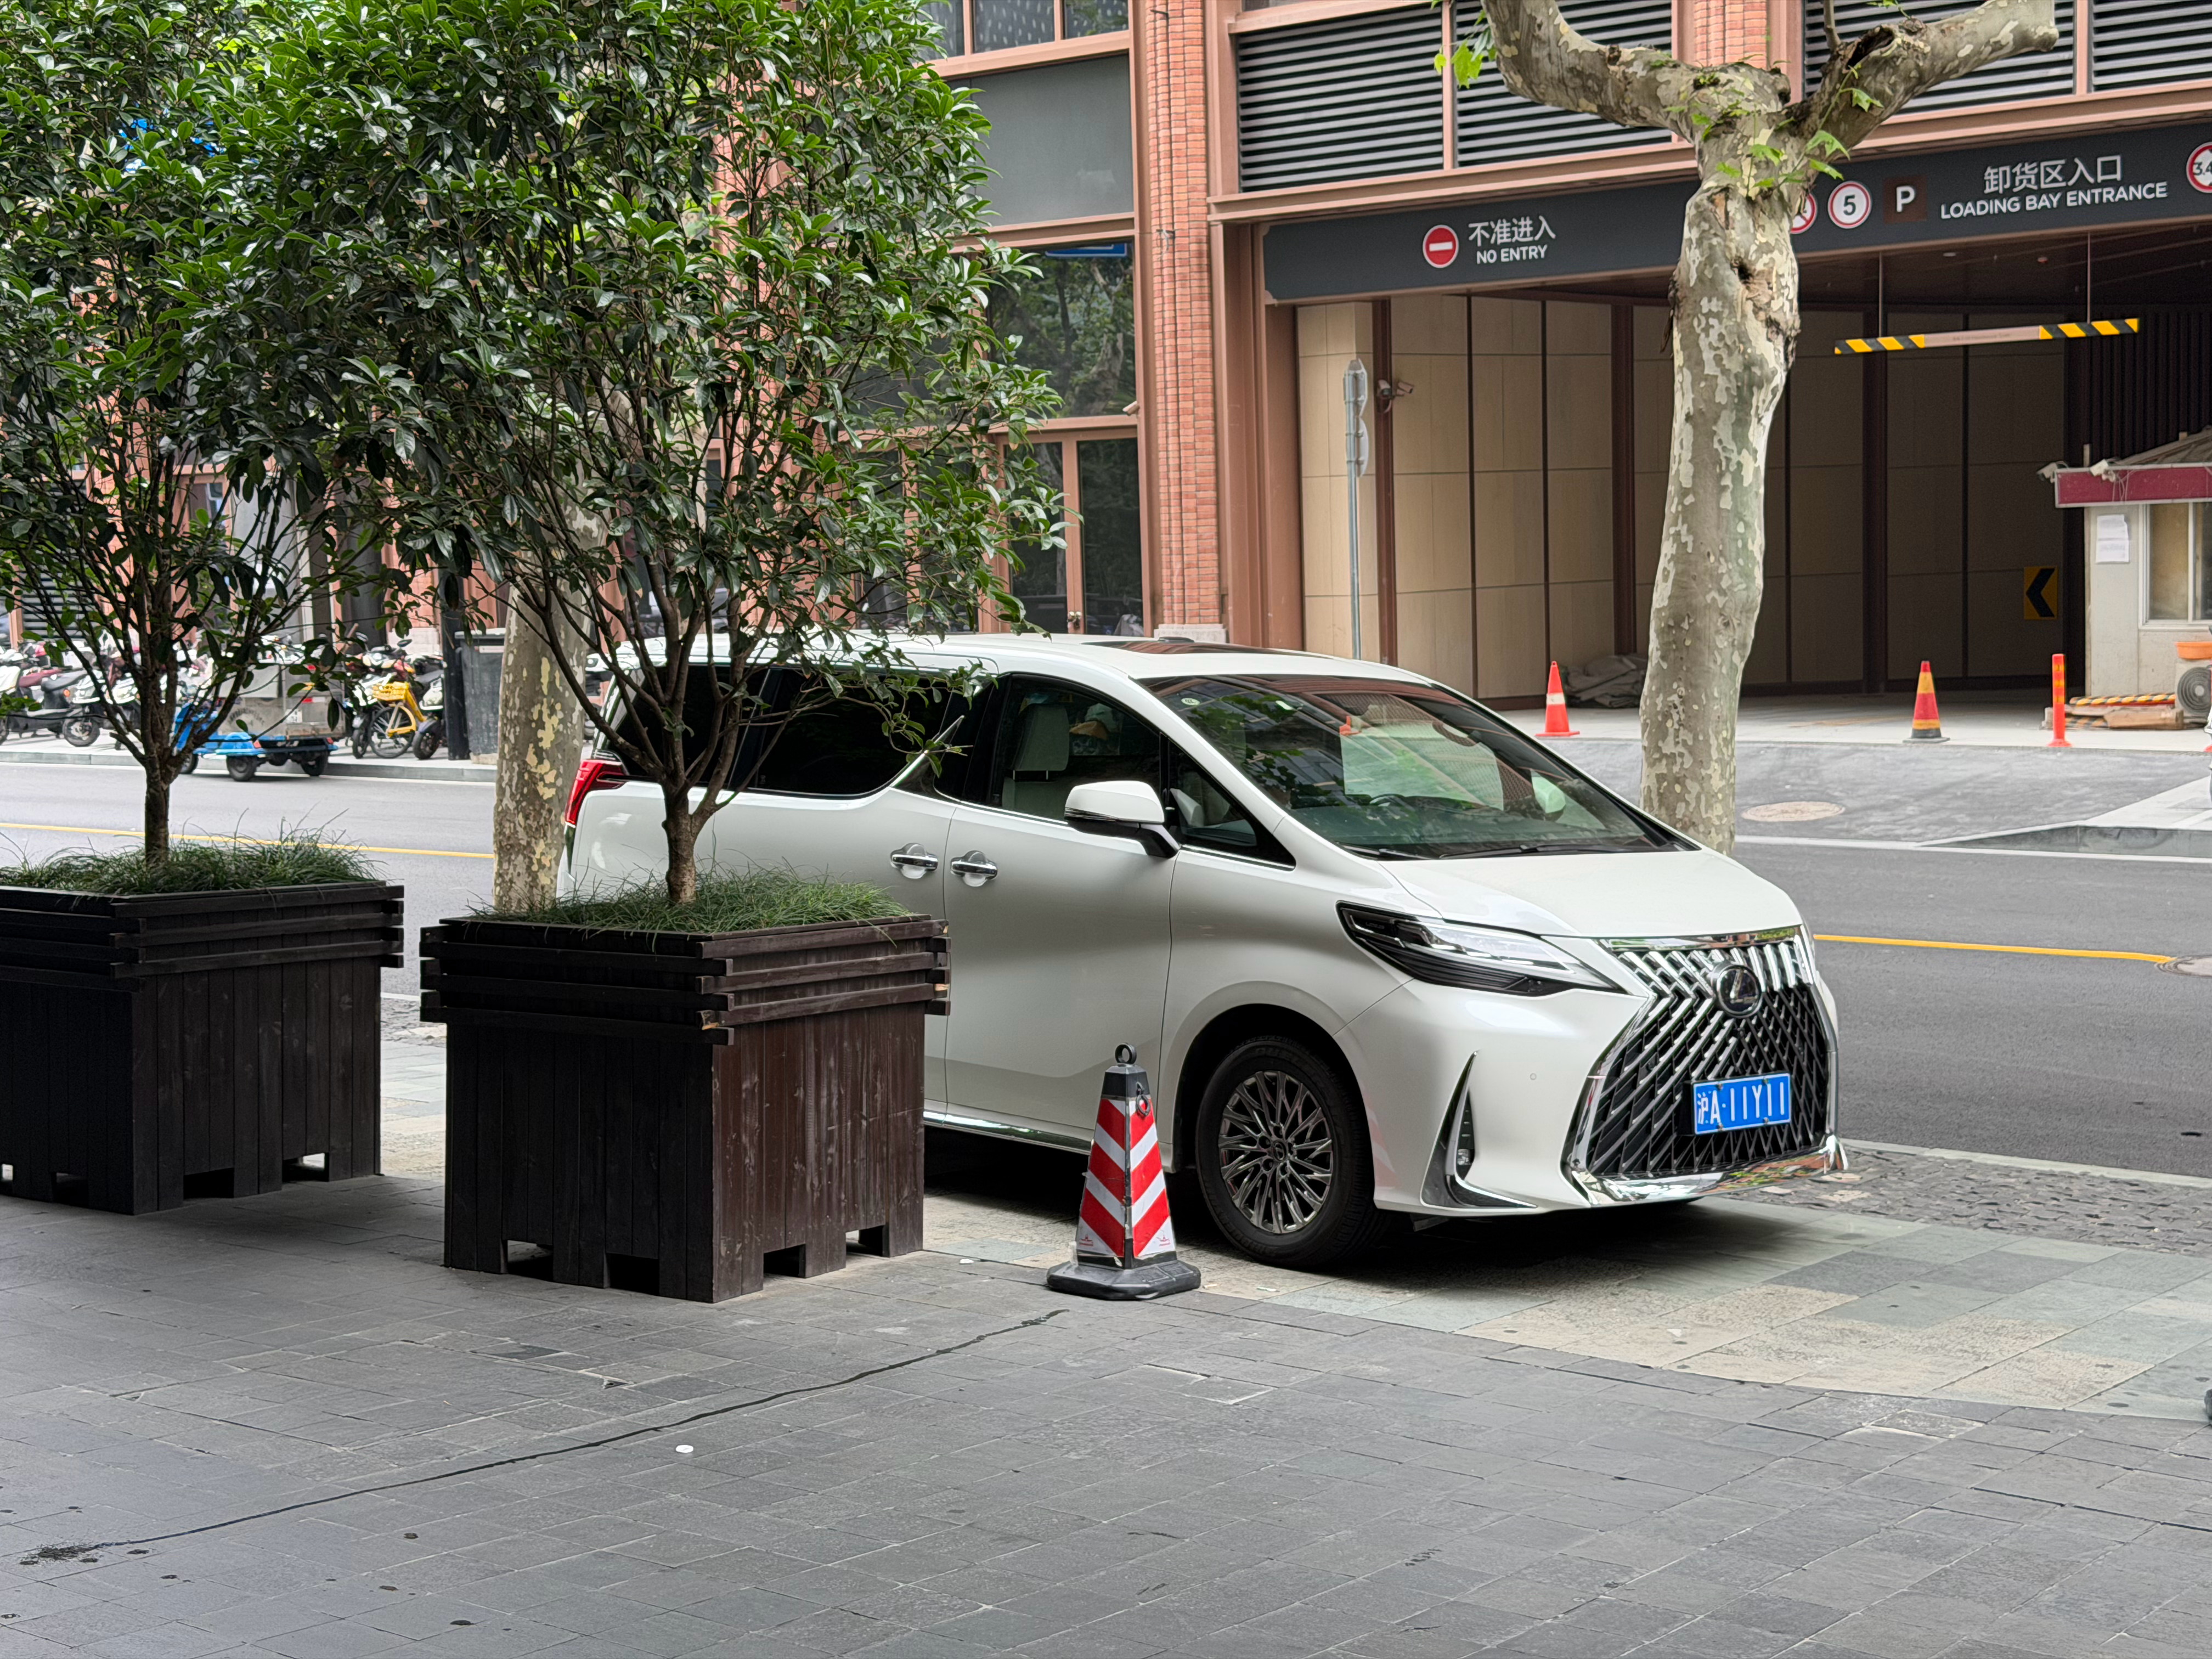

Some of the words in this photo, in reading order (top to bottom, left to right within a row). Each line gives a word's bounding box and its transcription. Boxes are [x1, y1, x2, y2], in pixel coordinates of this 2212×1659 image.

[1983, 155, 2122, 194] 卸货区入口
[1843, 194, 1856, 216] 5
[1896, 185, 1916, 213] P
[1940, 196, 2021, 219] LOADING
[2025, 192, 2062, 211] BAY
[2067, 181, 2168, 207] ENTRANCE
[1468, 216, 1556, 247] 不准进入
[1476, 250, 1497, 264] NO
[1500, 244, 1548, 262] ENTRY
